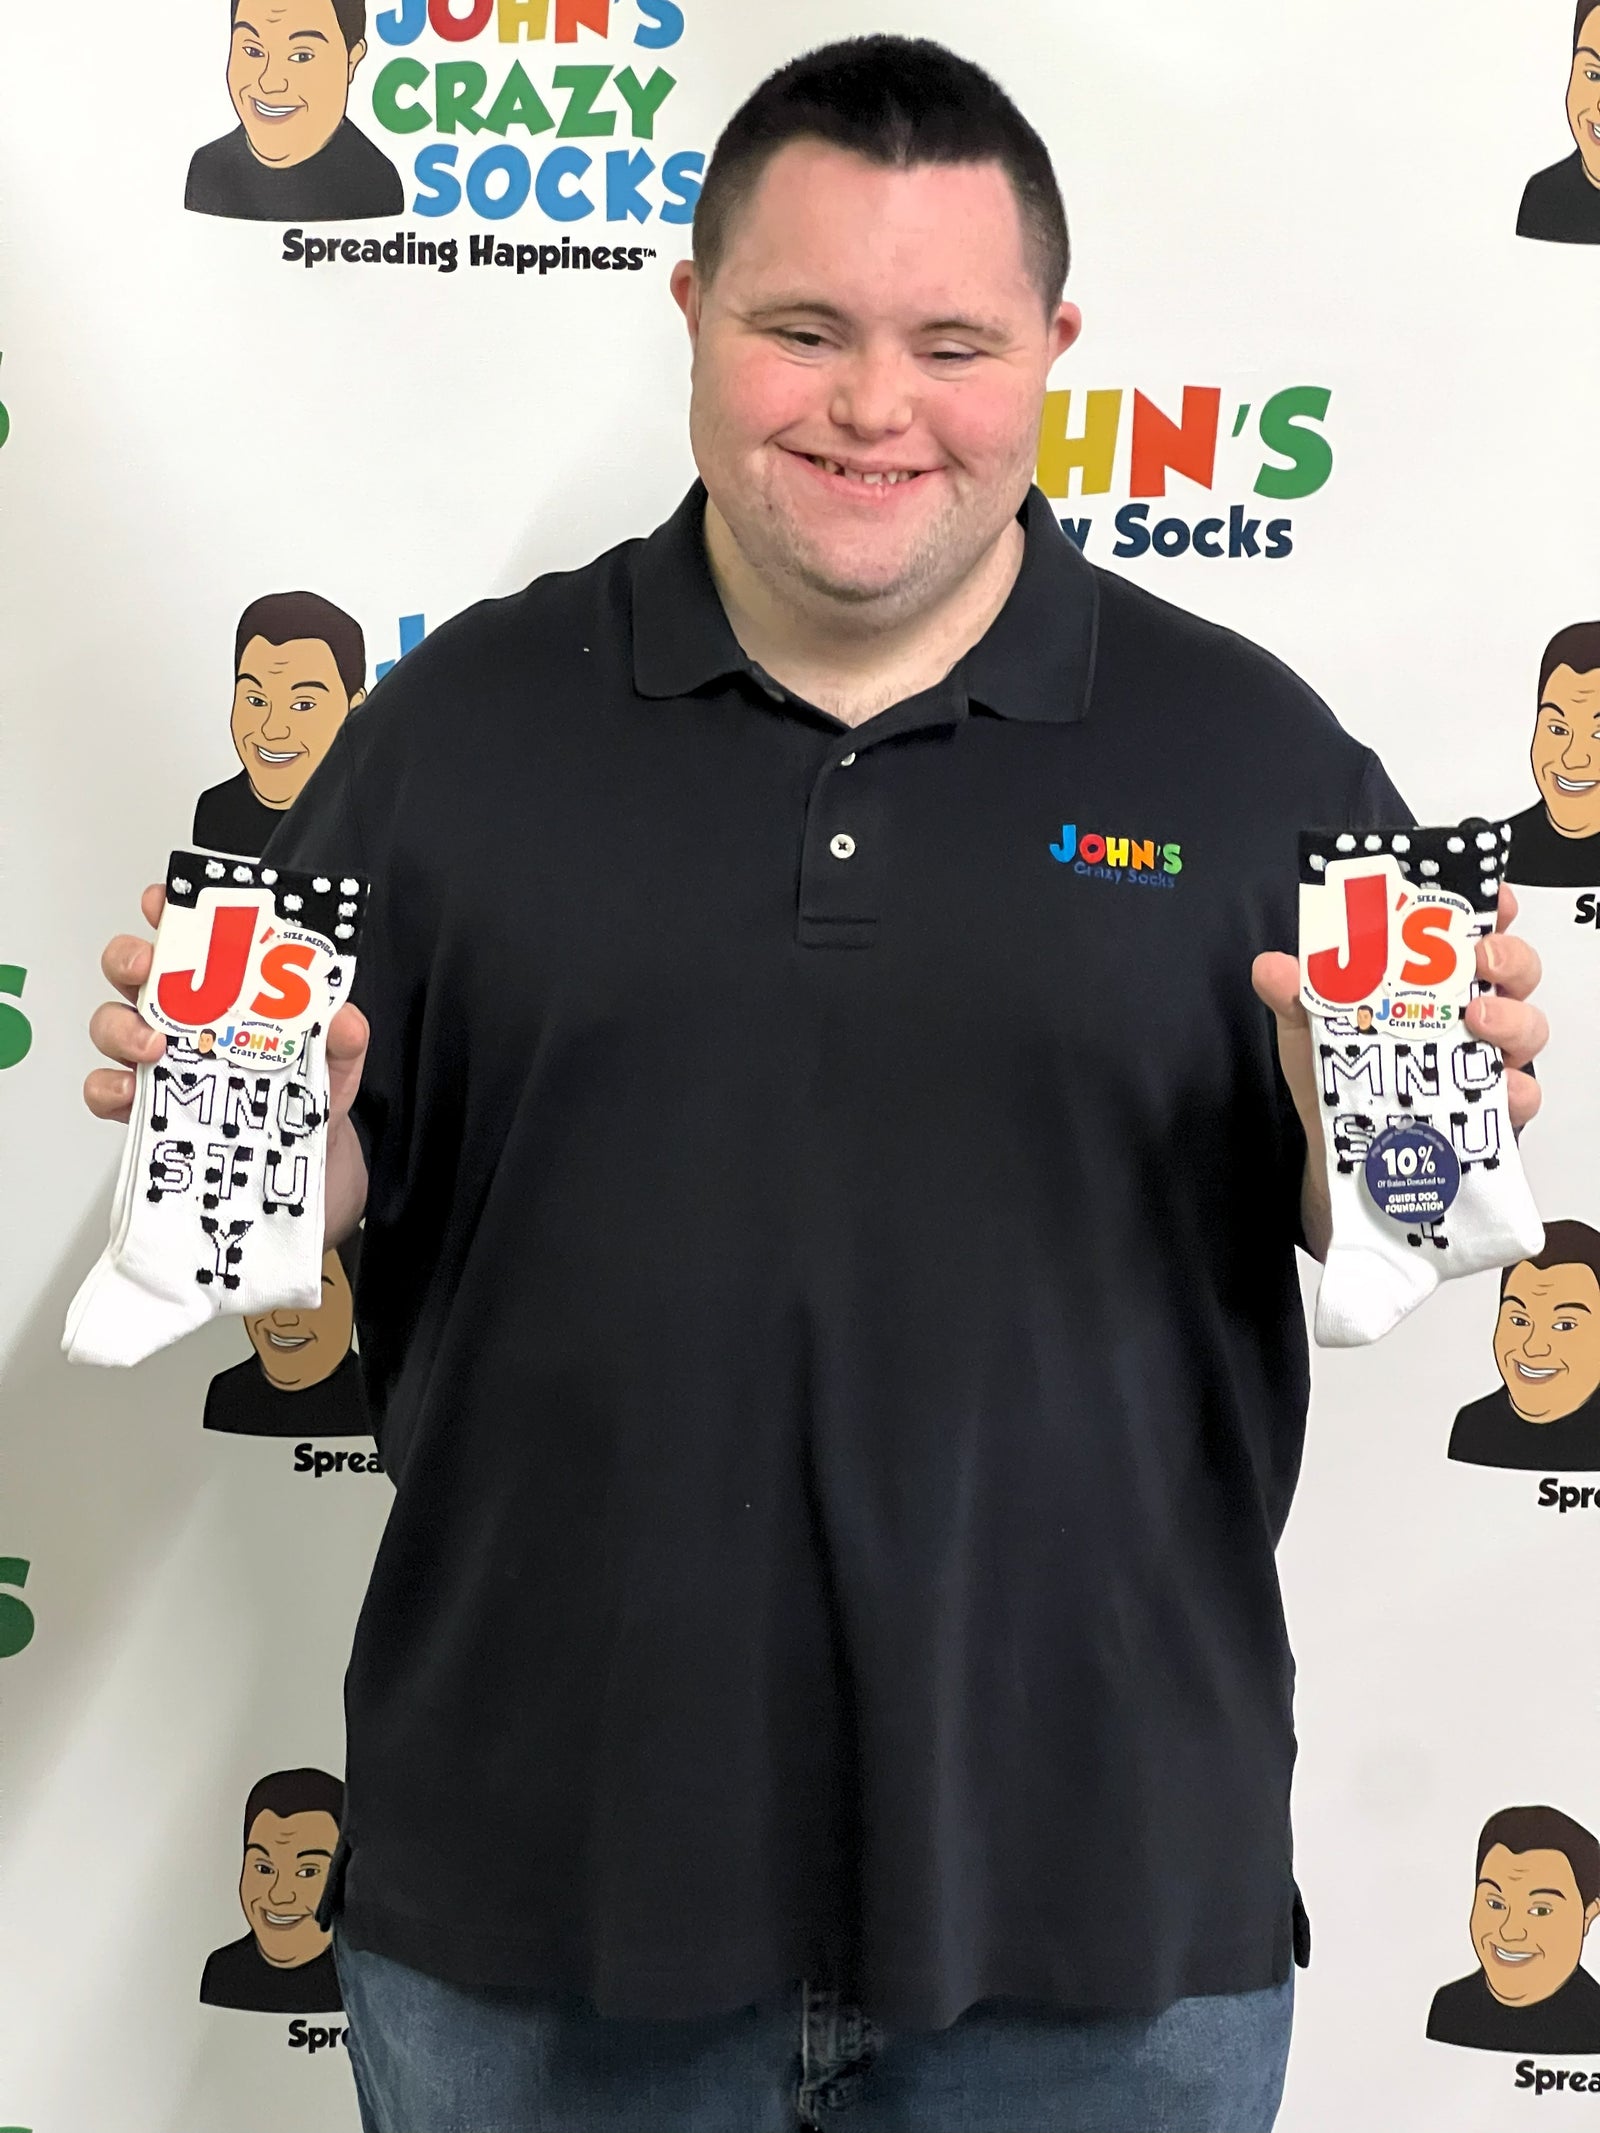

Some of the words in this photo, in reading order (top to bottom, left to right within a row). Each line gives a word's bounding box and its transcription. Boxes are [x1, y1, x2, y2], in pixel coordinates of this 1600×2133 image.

[372, 57, 677, 140] CRAZY
[412, 144, 705, 225] SOCKS
[282, 228, 458, 273] Spreading
[1112, 503, 1293, 558] Socks
[1049, 824, 1182, 874] JOHN'S
[1074, 861, 1122, 884] Crazy
[1127, 869, 1175, 888] Socks
[283, 931, 303, 941] SIZE
[1375, 998, 1452, 1021] JOHN'S
[217, 1026, 296, 1056] JOHN'S
[229, 1046, 257, 1059] Crazy
[260, 1051, 287, 1064] Socks
[1381, 1145, 1436, 1177] 10%
[1385, 1201, 1444, 1214] FOUNDATION
[1388, 1193, 1416, 1204] GUIDE
[293, 1442, 385, 1478] Sprea
